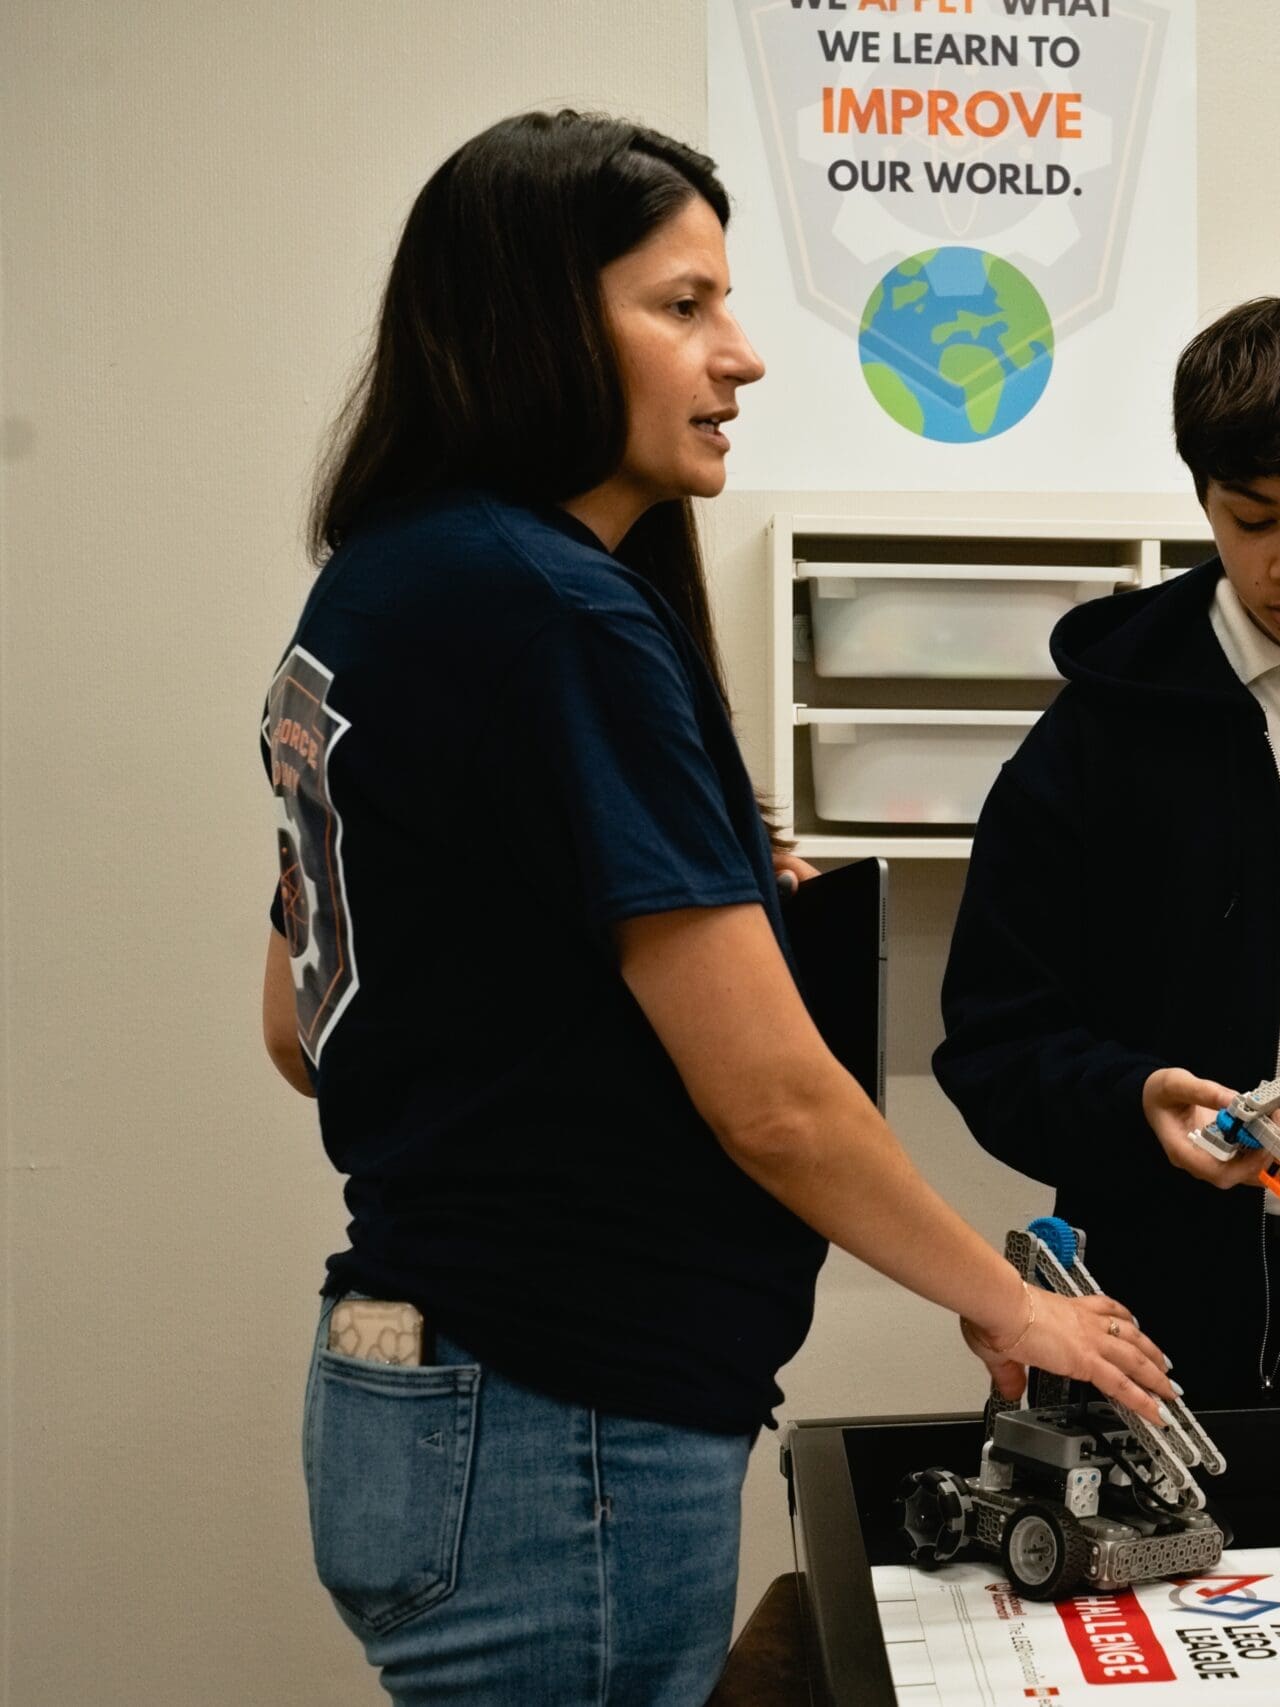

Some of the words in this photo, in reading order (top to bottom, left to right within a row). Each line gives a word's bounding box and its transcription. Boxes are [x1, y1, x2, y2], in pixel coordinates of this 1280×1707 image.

[818, 30, 880, 63] WE
[893, 32, 1018, 67] LEARN
[1029, 36, 1080, 68] TO
[822, 87, 1082, 139] IMPROVE
[828, 159, 913, 193] OUR
[924, 161, 1082, 197] WORLD.
[1072, 1595, 1149, 1677] HALLENGE
[1175, 1628, 1240, 1680] LEAGUE
[1222, 1625, 1278, 1660] LEGO
